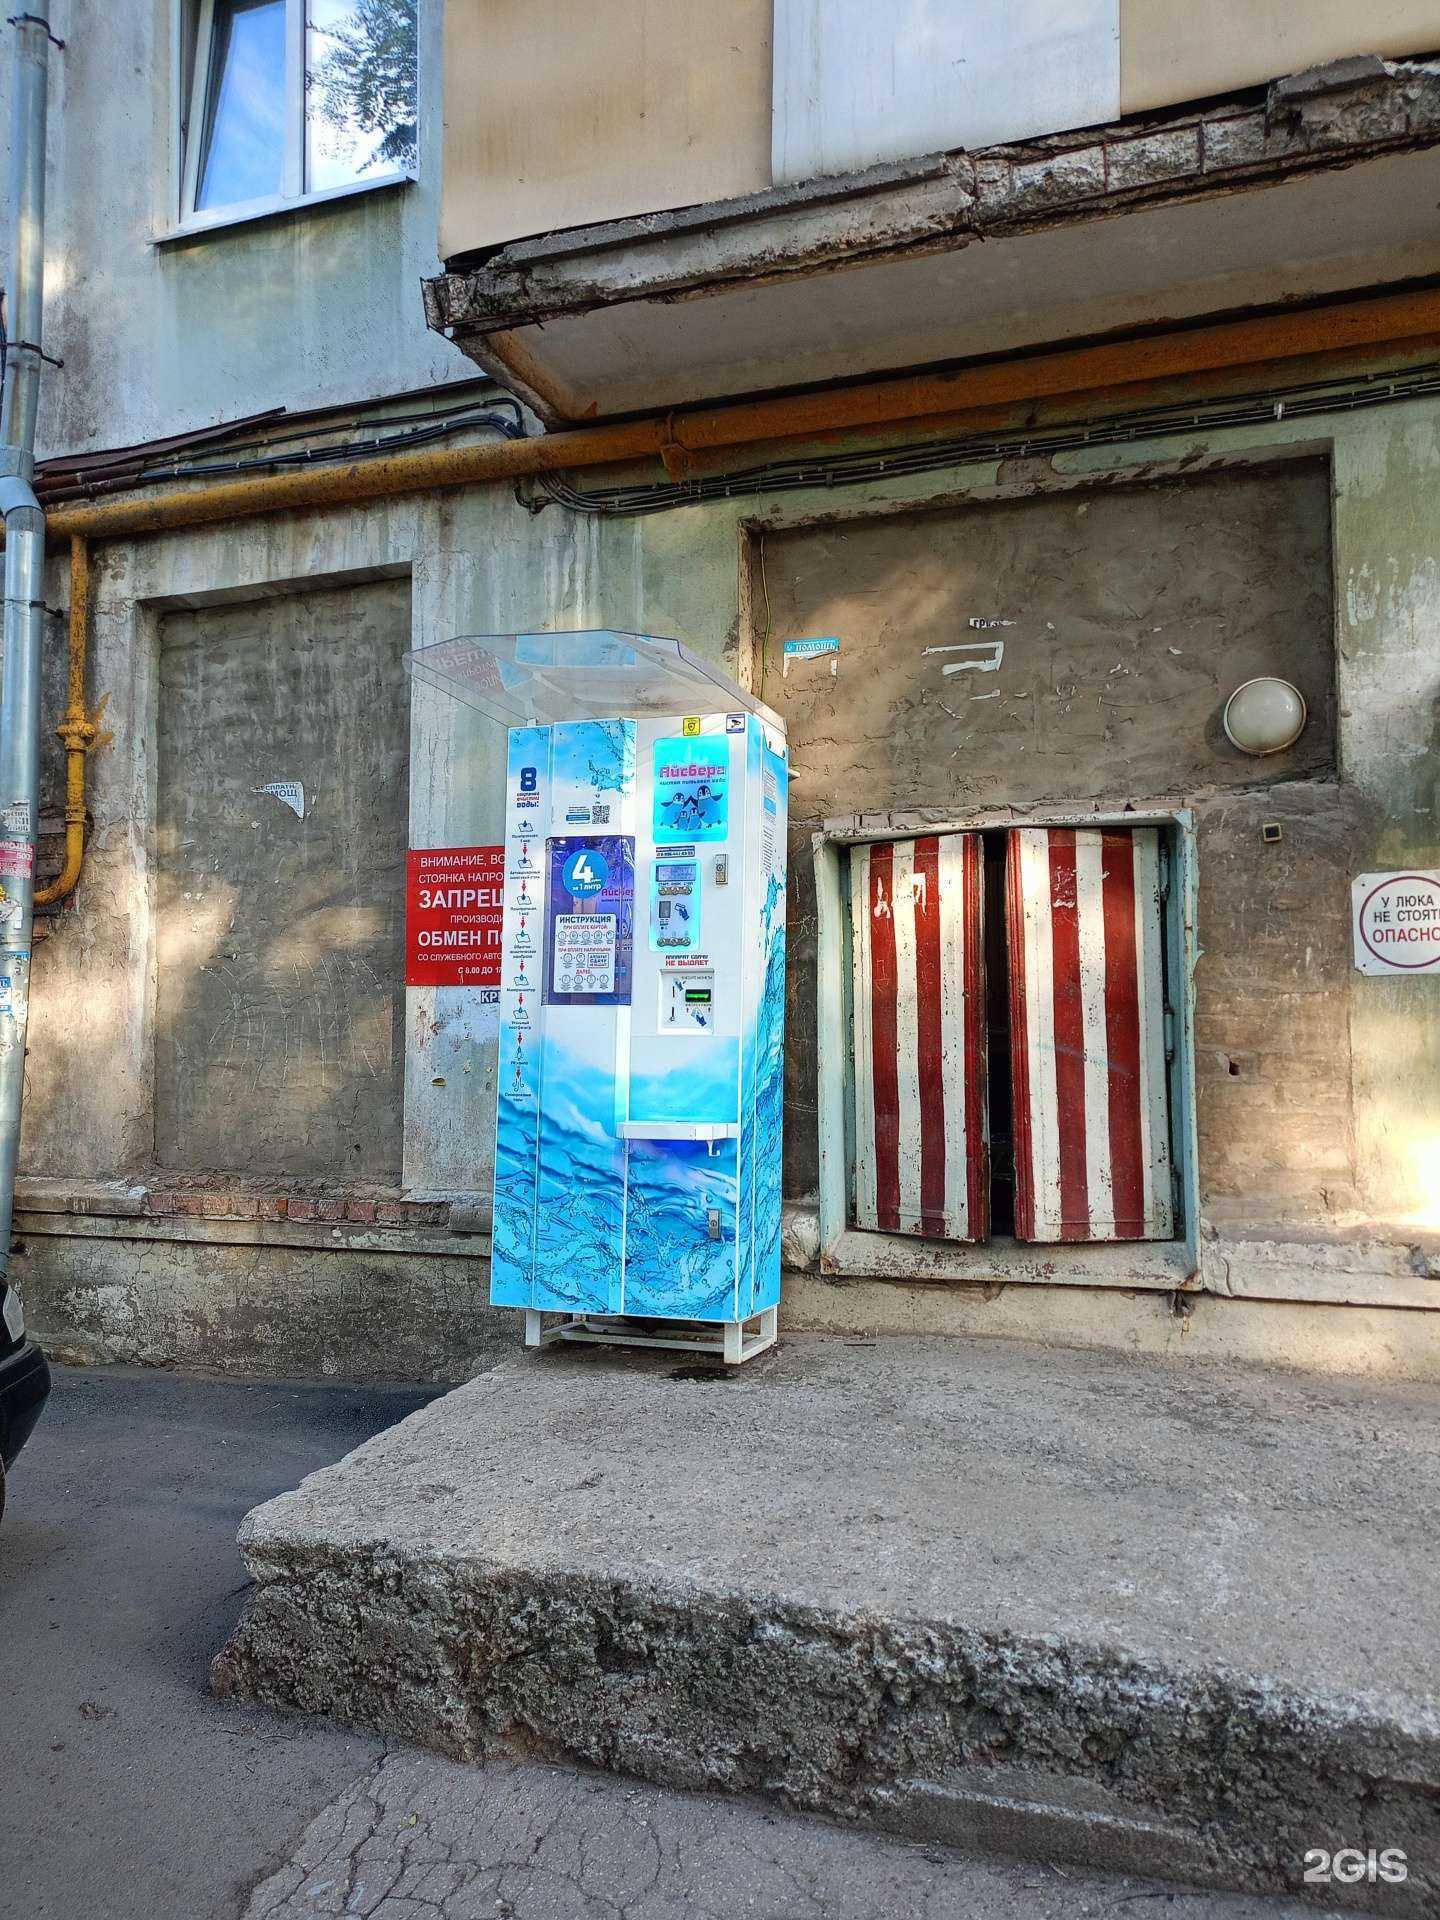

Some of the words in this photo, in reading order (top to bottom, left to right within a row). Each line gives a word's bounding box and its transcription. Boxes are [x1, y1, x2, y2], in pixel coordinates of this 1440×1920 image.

[521, 767, 537, 791] 8
[420, 854, 487, 868] ВНИМАНИЕ,
[572, 854, 594, 883] 4
[418, 873, 465, 884] СТОЯНКА
[468, 872, 503, 882] НАПРО
[1381, 896, 1390, 908] У
[1396, 894, 1434, 908] ЛЮКА
[559, 915, 612, 923] ИНСТРУКЦИЯ
[1374, 911, 1391, 923] НЕ
[418, 930, 481, 946] ОБМЕН
[1372, 927, 1440, 943] ОПАСНО
[430, 953, 482, 961] СЛУЖЕБНОГО
[481, 966, 493, 975] ДО
